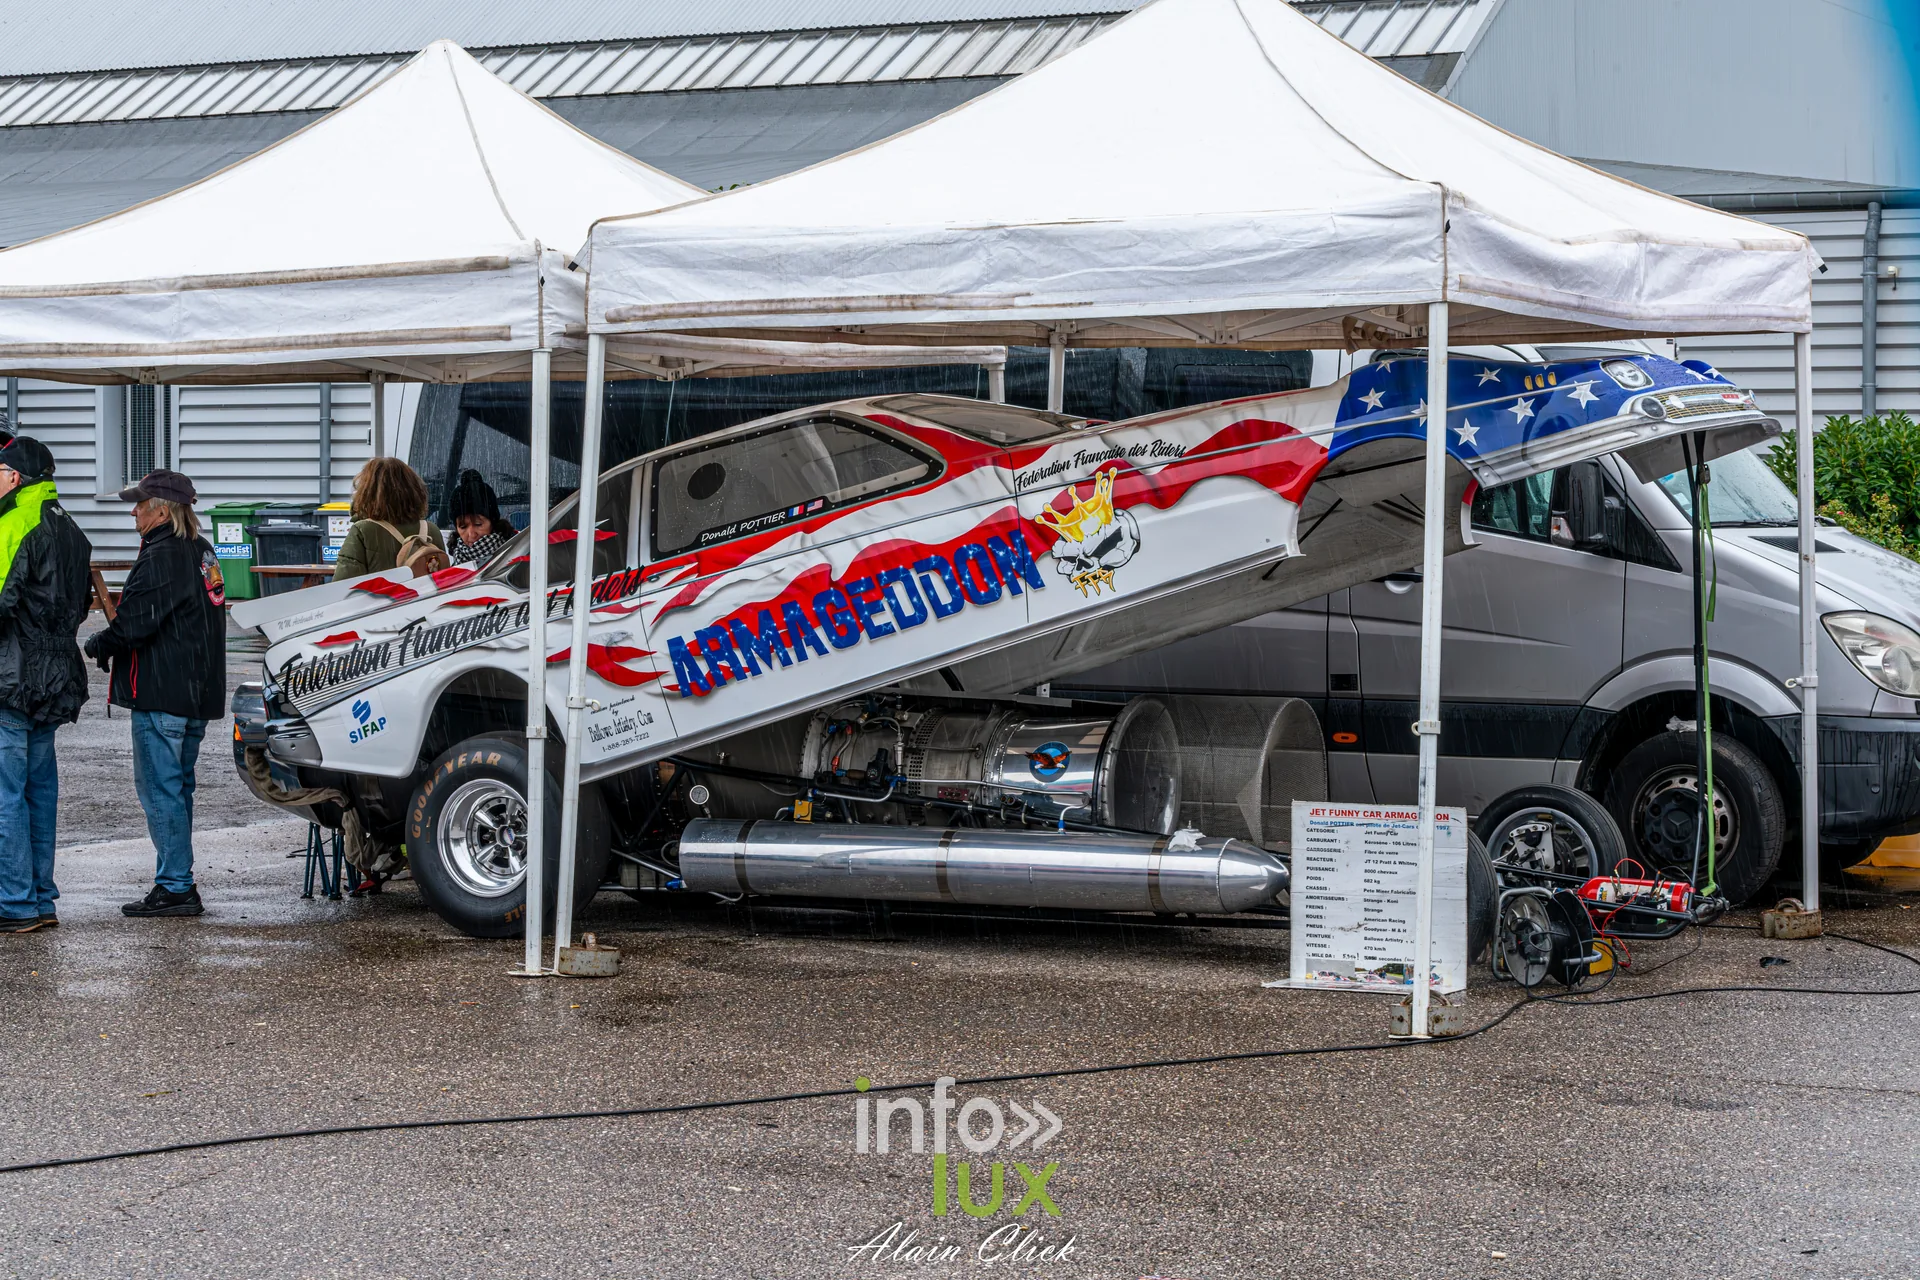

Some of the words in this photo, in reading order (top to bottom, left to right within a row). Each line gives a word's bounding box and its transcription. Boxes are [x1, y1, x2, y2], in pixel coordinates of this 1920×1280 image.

[1014, 459, 1071, 492] Fédération
[1073, 445, 1126, 469] Française
[1128, 443, 1148, 457] des
[1150, 439, 1187, 458] Riders
[701, 525, 736, 542] Donald
[740, 511, 786, 532] POTTIER
[214, 545, 236, 554] Grand
[237, 545, 250, 554] Est
[666, 529, 1046, 698] ARMAGEDDON
[279, 638, 392, 701] Fédération
[398, 601, 510, 667] Française
[349, 716, 387, 744] SIFAP
[412, 751, 501, 839] GOODYEAR
[1310, 808, 1327, 816] JET
[1329, 809, 1361, 817] FUNNY
[1384, 811, 1450, 821] ARMAGON
